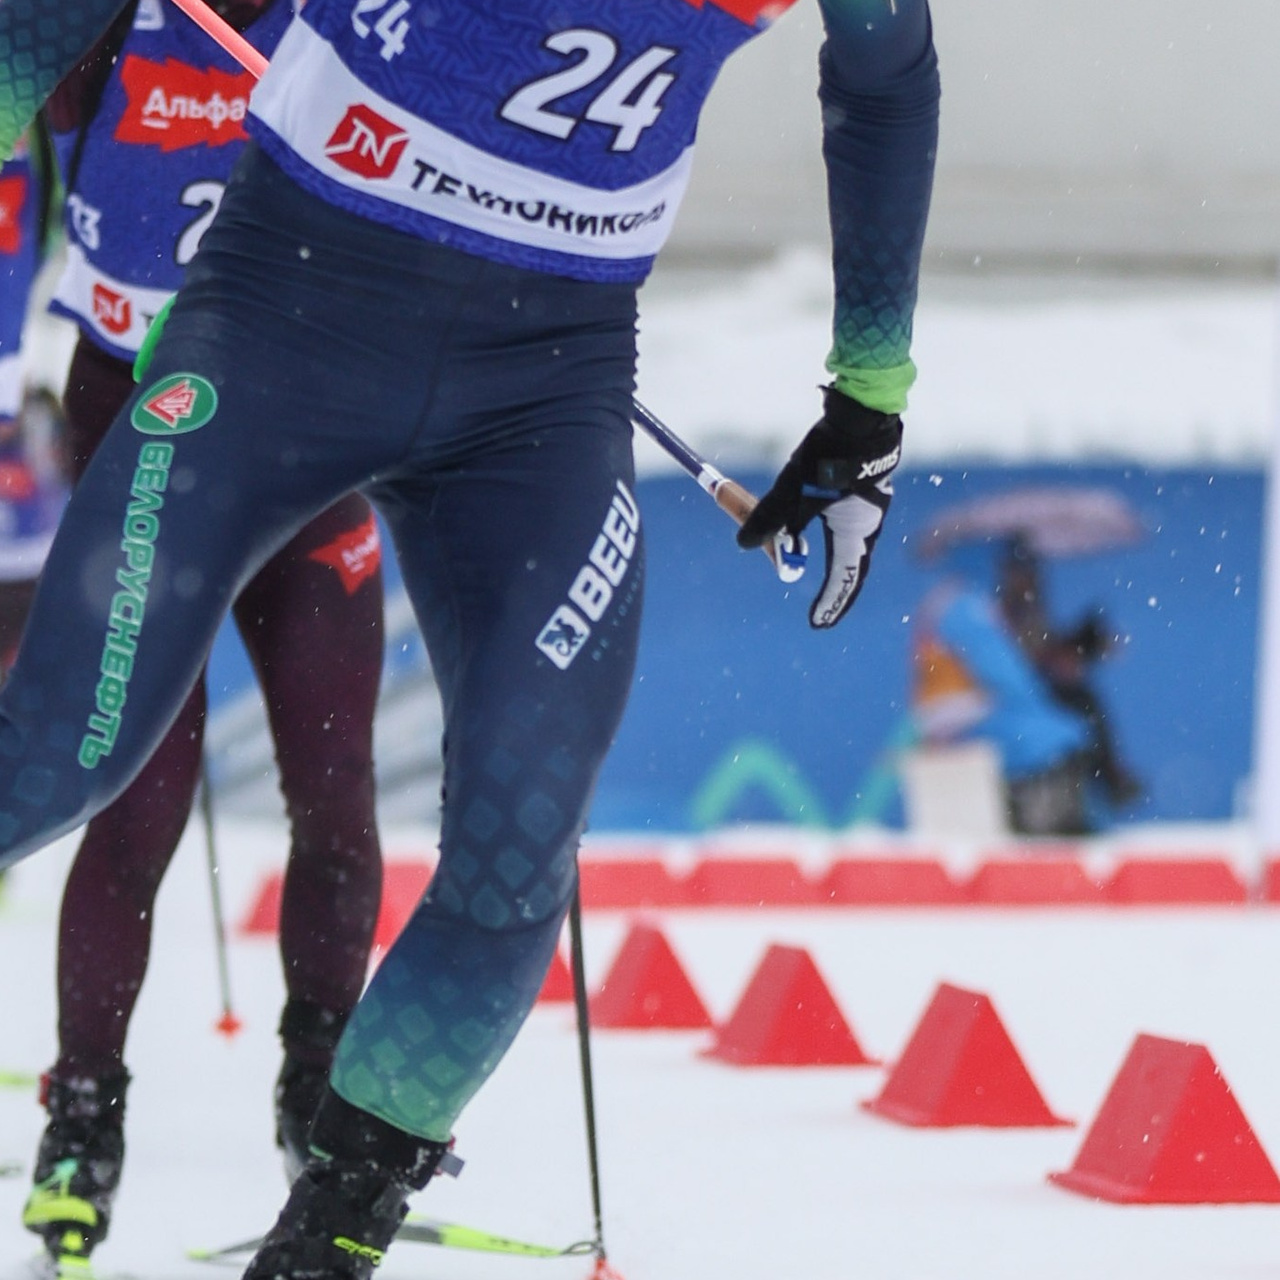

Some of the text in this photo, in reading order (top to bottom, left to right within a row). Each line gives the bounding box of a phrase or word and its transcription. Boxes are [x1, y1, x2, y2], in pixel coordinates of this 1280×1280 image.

[140, 86, 246, 130] Альфа
[498, 27, 677, 154] 24
[78, 441, 175, 769] БЕЛОРУСНЕФТЬ
